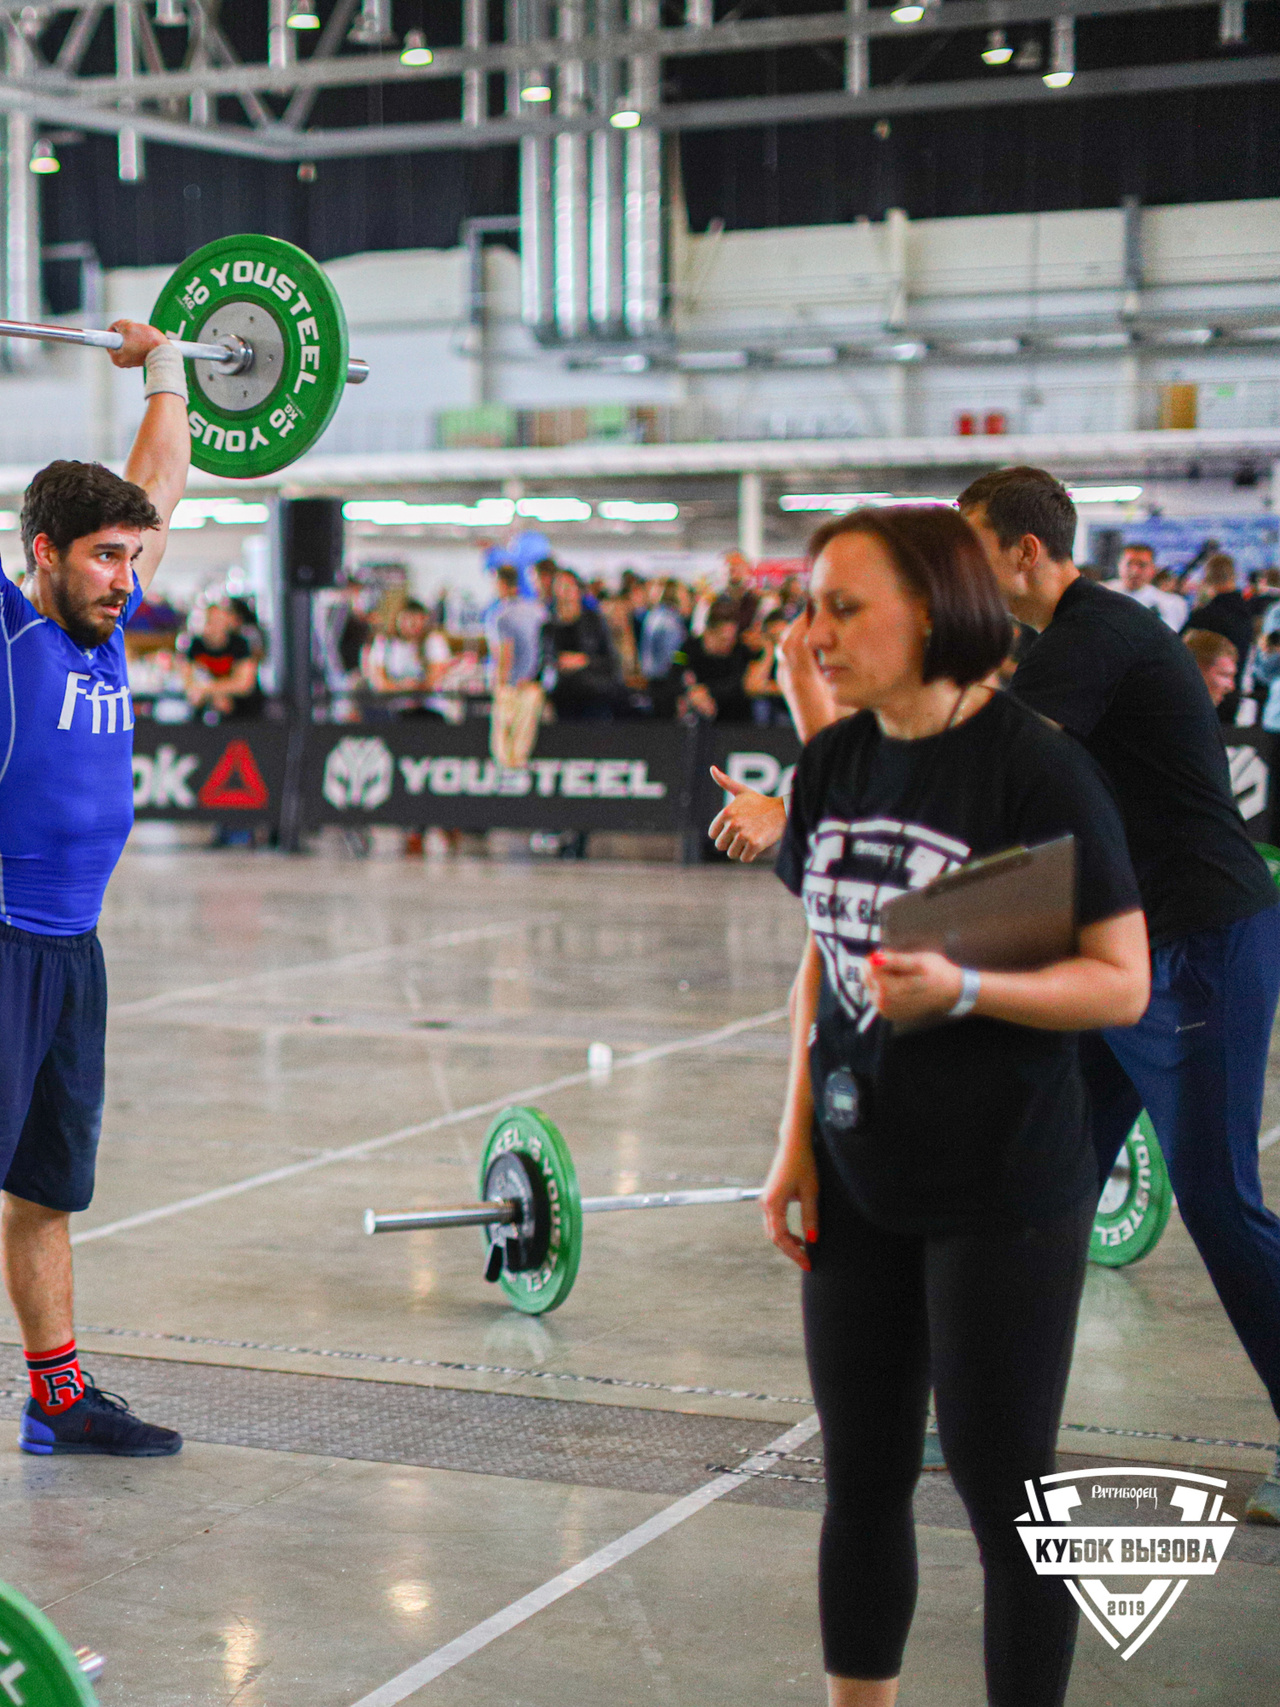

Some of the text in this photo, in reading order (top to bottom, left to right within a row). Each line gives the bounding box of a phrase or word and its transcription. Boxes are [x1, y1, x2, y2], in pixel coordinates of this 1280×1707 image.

[182, 294, 196, 310] KG
[185, 276, 210, 305] 10
[210, 260, 320, 394] YOUSTEEL
[269, 408, 295, 438] 10
[284, 403, 299, 421] KG
[400, 757, 666, 799] YOUSTEEL
[1095, 1123, 1151, 1246] YOUSTEEL
[41, 1368, 84, 1406] R
